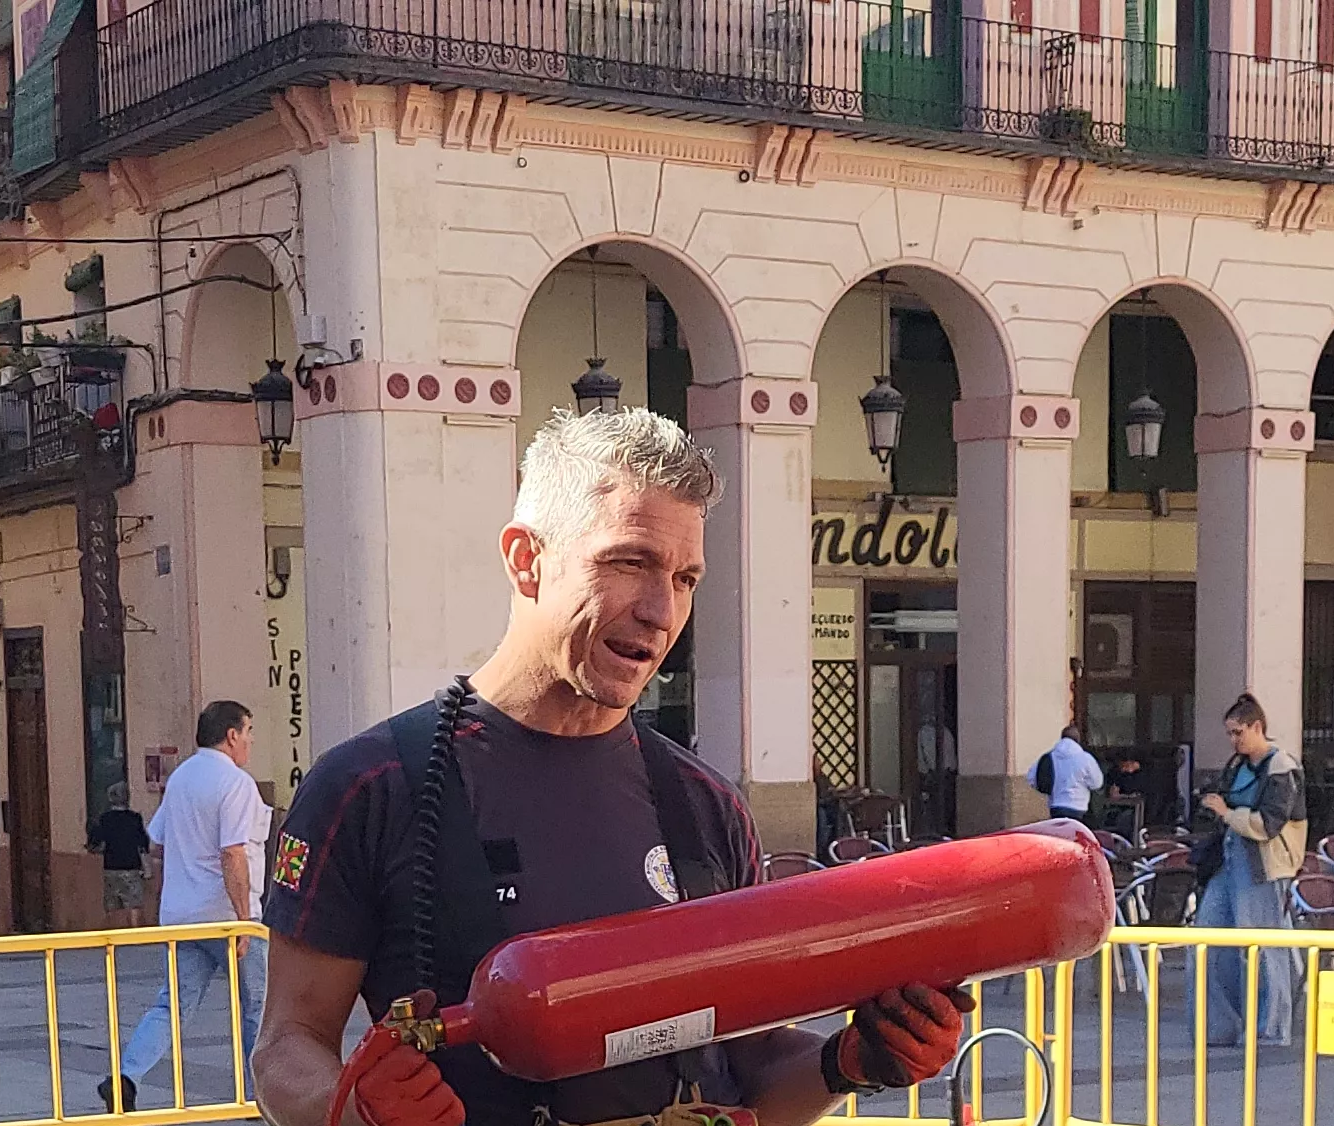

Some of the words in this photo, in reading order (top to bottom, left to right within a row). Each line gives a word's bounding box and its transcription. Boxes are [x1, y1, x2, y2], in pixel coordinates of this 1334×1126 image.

[812, 494, 958, 568] ndol
[267, 617, 282, 687] SIN
[812, 628, 850, 638] MANDO
[496, 887, 517, 901] 74
